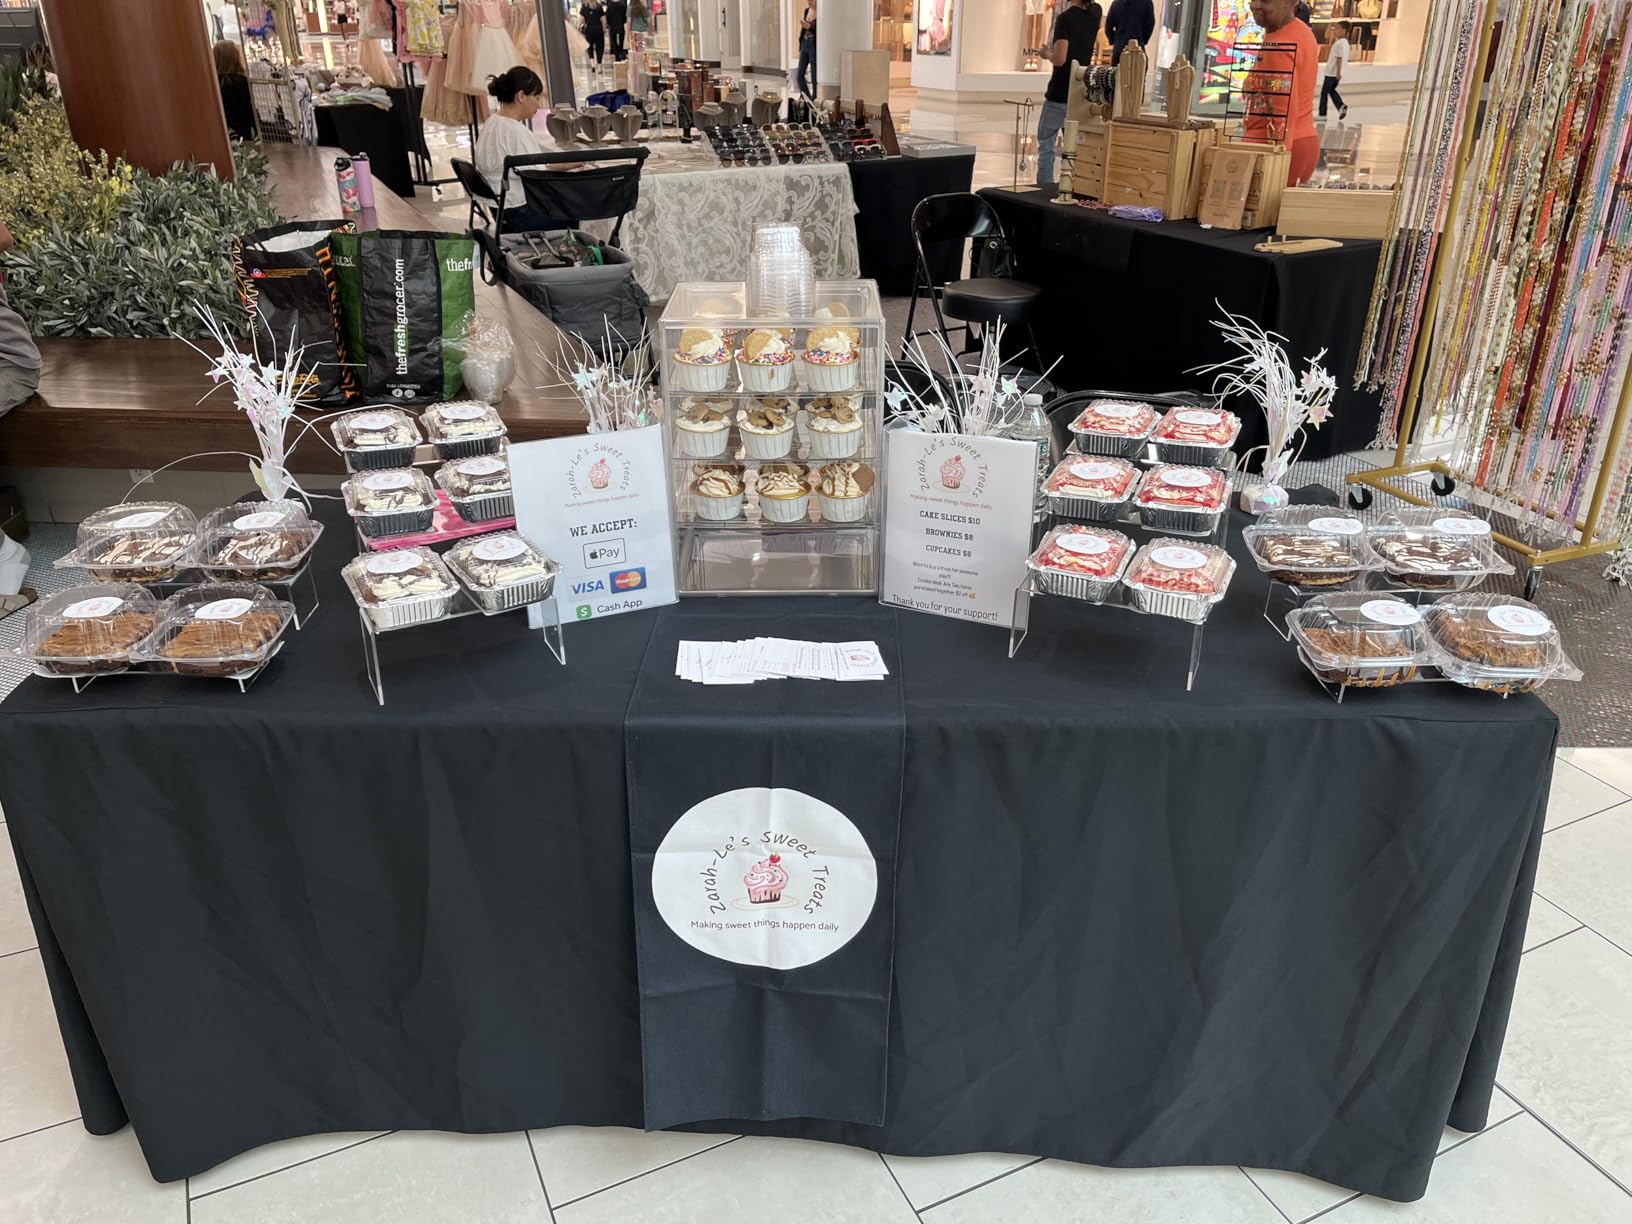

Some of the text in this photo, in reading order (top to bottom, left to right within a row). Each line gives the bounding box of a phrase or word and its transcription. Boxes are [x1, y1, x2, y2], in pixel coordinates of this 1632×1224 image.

[394, 258, 408, 375] thefreshgrocer.com
[594, 442, 623, 459] Sweet
[620, 459, 631, 490] Treats
[916, 436, 988, 498] Zarah-Le's Sweet Treats
[919, 510, 981, 525] CAKE SLICES $10
[569, 518, 638, 537] WE ACCEPT:
[925, 528, 974, 541] BROWNIES $8
[599, 547, 620, 559] Pay
[925, 544, 961, 556] CUPCAKES
[571, 580, 605, 595] VISA
[597, 603, 621, 613] Cash
[623, 600, 643, 609] App
[892, 594, 998, 621] Thank you for your support!
[700, 831, 829, 914] Zarah-Le's Sweet Treats
[691, 919, 839, 932] Making sweet things happen daily
